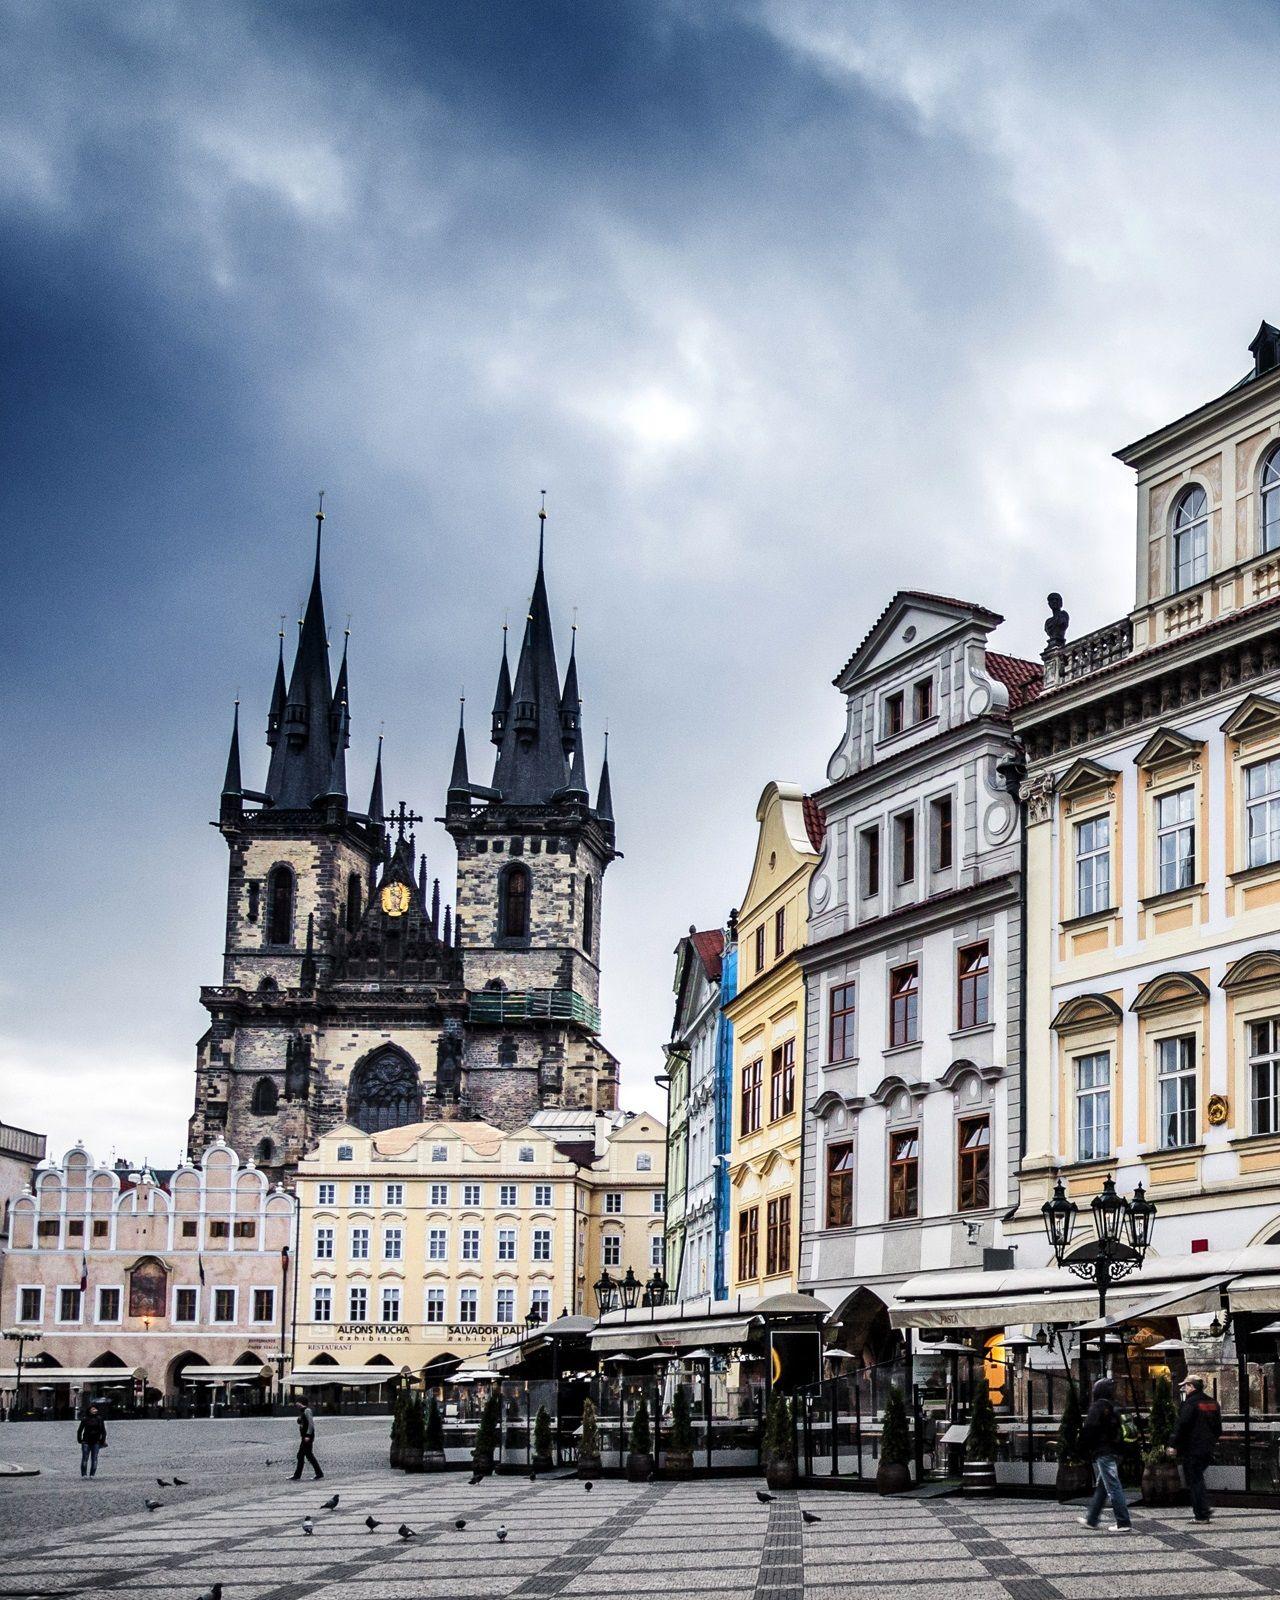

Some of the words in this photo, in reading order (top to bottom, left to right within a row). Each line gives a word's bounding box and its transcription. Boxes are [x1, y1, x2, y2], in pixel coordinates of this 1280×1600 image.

[337, 1325, 373, 1335] ALFONS
[375, 1325, 410, 1335] MUCHA
[448, 1326, 499, 1335] SALVADOR
[307, 1343, 352, 1351] RESTAURANT
